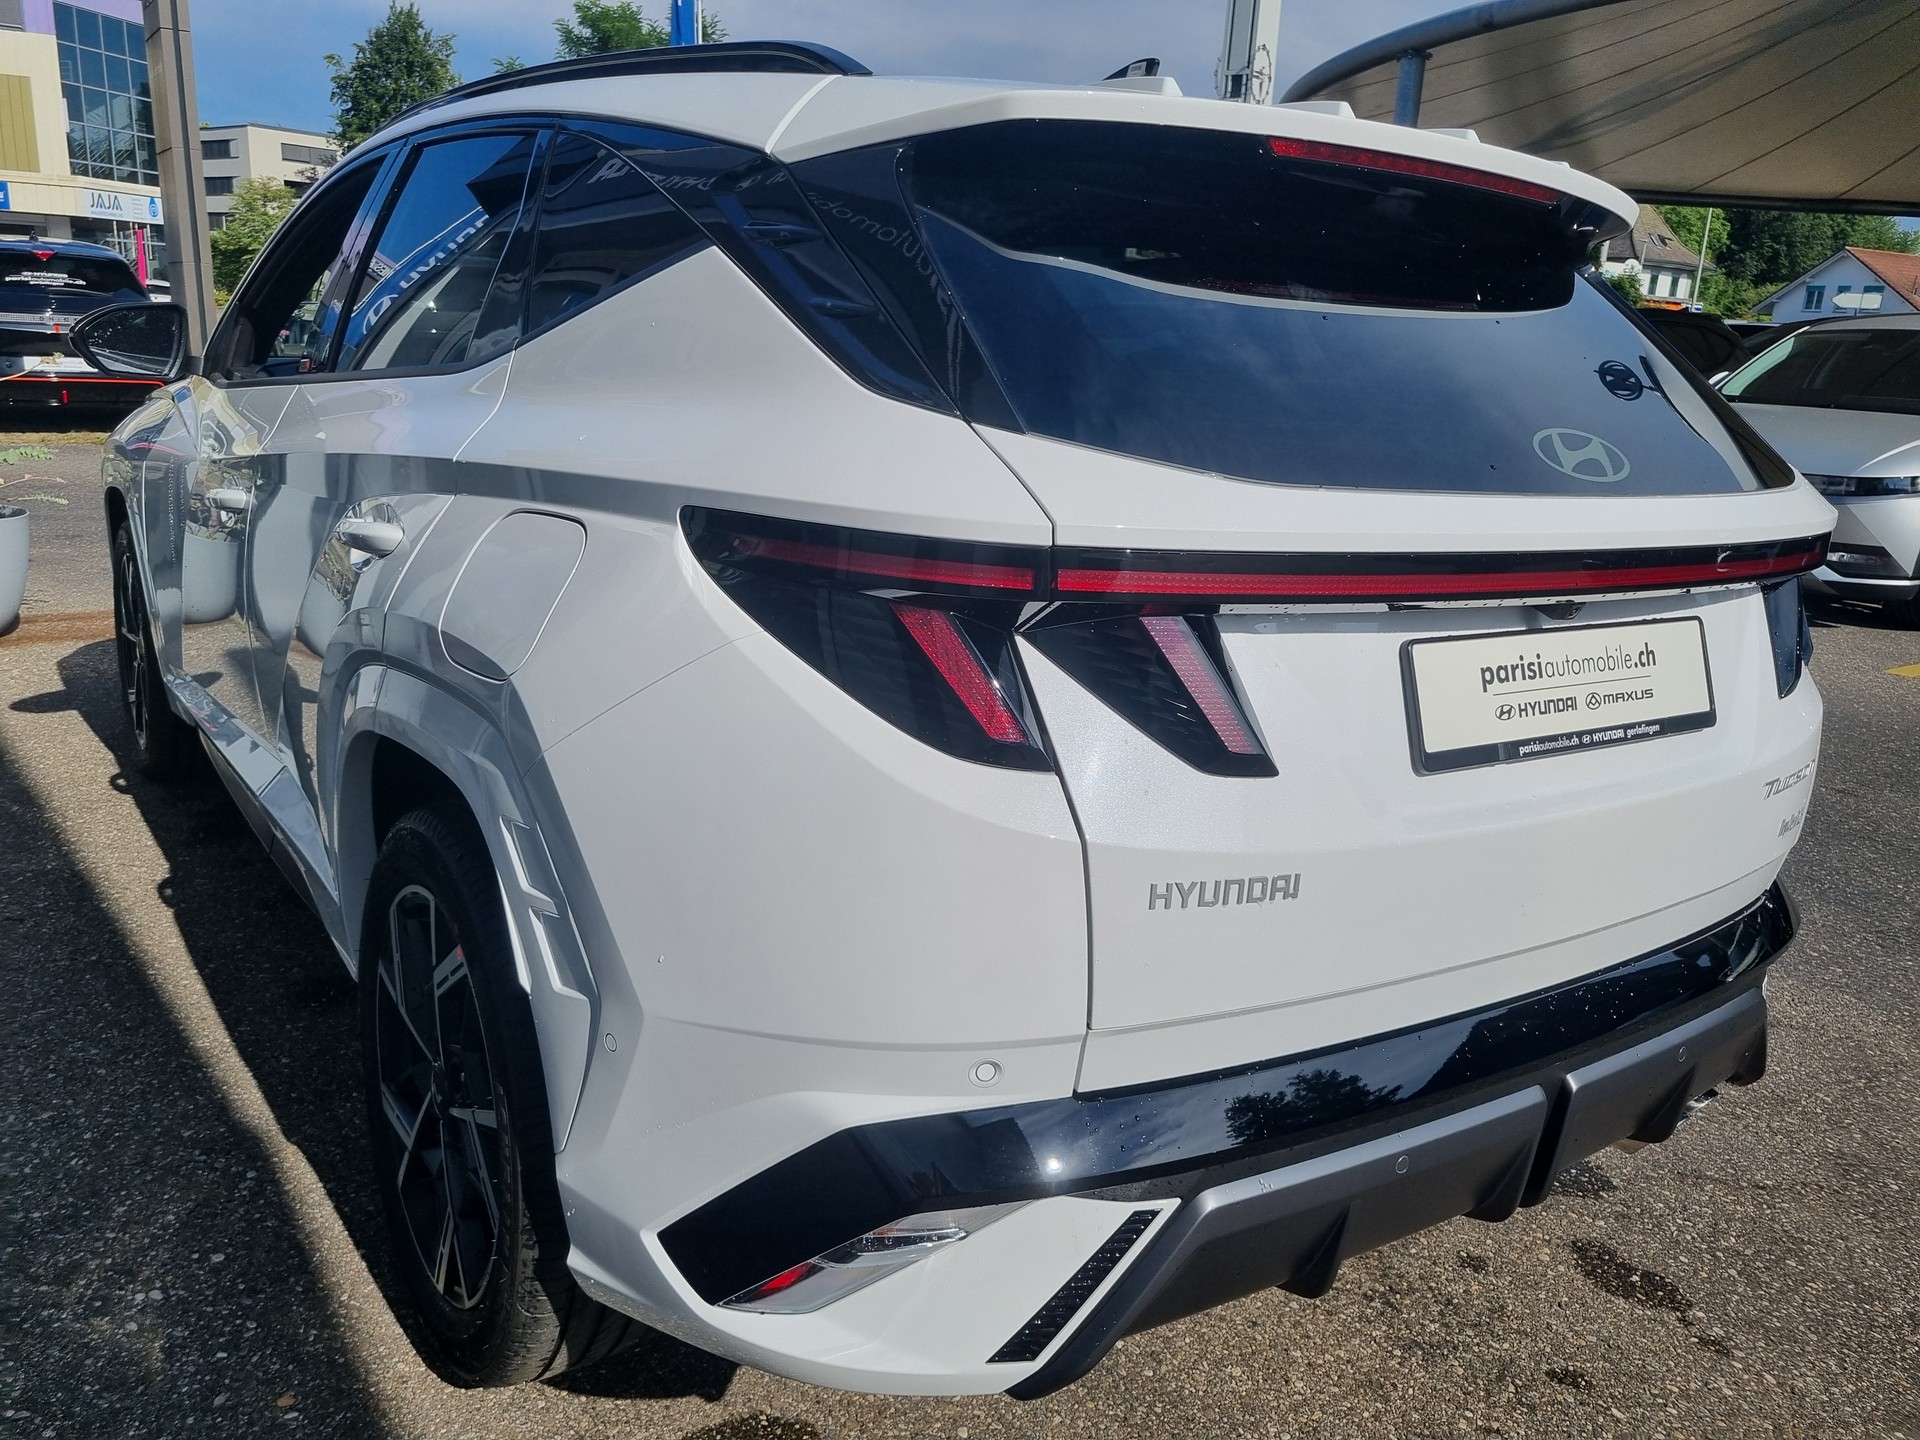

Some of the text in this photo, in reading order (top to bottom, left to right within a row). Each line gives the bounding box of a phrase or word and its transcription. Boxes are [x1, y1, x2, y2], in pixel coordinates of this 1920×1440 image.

[90, 192, 123, 212] JAJA
[1480, 642, 1657, 693] parisiautomobile.ch
[1518, 688, 1654, 718] HYUNDAI MAXUS
[1518, 724, 1661, 757] parisiautomobile.ch HYUNDAI gerlafingen
[1148, 873, 1302, 911] HYUNDAI
